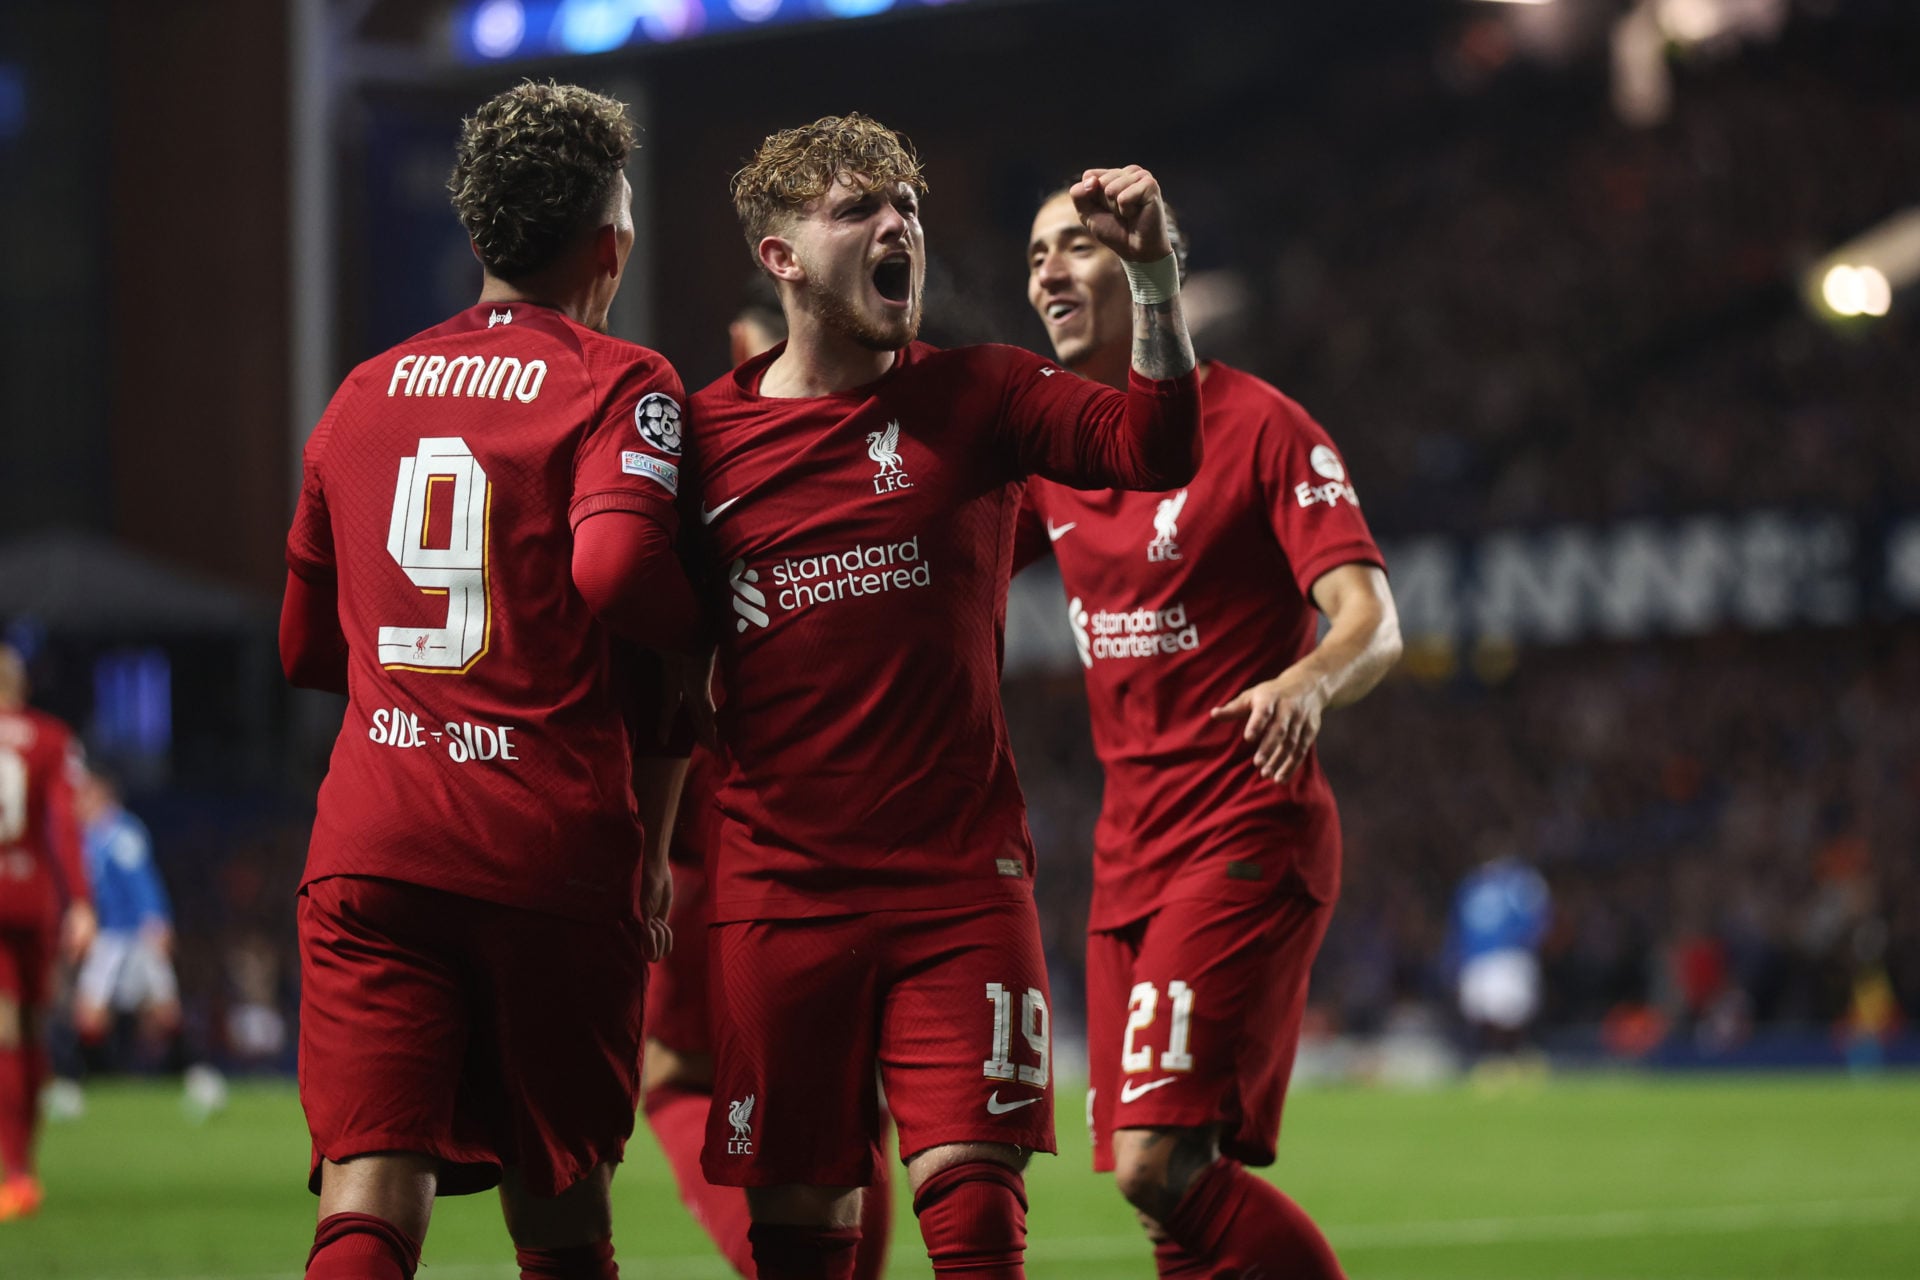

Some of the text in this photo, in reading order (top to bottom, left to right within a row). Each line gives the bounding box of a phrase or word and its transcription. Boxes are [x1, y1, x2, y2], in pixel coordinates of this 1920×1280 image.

[387, 355, 548, 404] FIRMINO
[660, 413, 675, 436] 6
[873, 473, 914, 495] L.F.C.
[378, 436, 492, 675] 9
[772, 535, 920, 586] standard
[778, 560, 931, 610] chartered
[1091, 602, 1187, 635] standard
[1093, 624, 1200, 659] chartered
[983, 982, 1049, 1090] 19
[1122, 980, 1196, 1074] 21
[727, 1141, 754, 1155] L.F.C.
